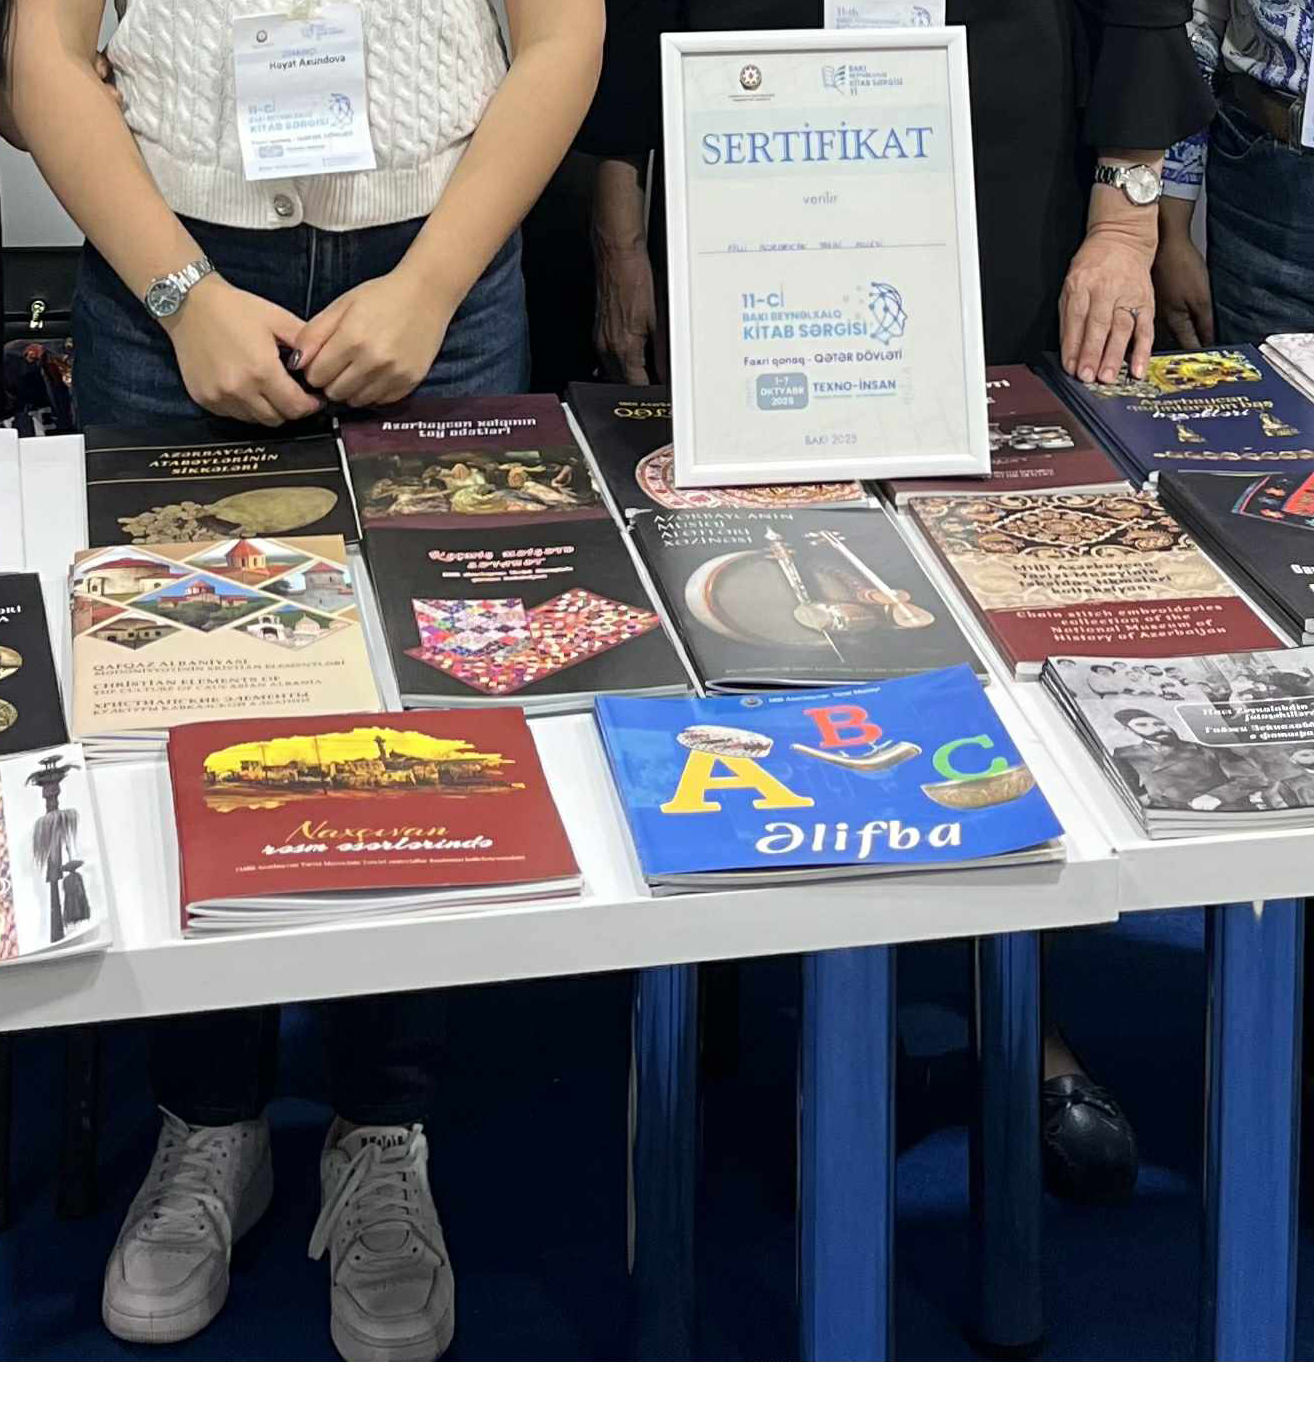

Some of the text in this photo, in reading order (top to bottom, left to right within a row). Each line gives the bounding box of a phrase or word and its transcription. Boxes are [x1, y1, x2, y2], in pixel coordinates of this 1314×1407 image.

[701, 121, 934, 166] SERTİFİKAT
[742, 312, 769, 322] BAKI
[743, 321, 867, 341] KİTAB SƏRGİSİ
[814, 351, 854, 364] QƏTƏR
[855, 348, 903, 362] DÖVLƏTİ
[813, 379, 897, 393] TEXNO-İNSAN
[382, 420, 472, 433] Azərbaycan
[418, 429, 445, 438] toy
[159, 446, 266, 459] AZƏRBAYCAN
[1016, 604, 1223, 619] Chain stitch embroideries
[1050, 618, 1213, 634] National Museum of
[1061, 612, 1191, 626] collection of the
[1053, 632, 1112, 642] History
[1118, 631, 1134, 640] of
[660, 705, 1009, 814] A B C
[755, 820, 962, 860] Əlifba
